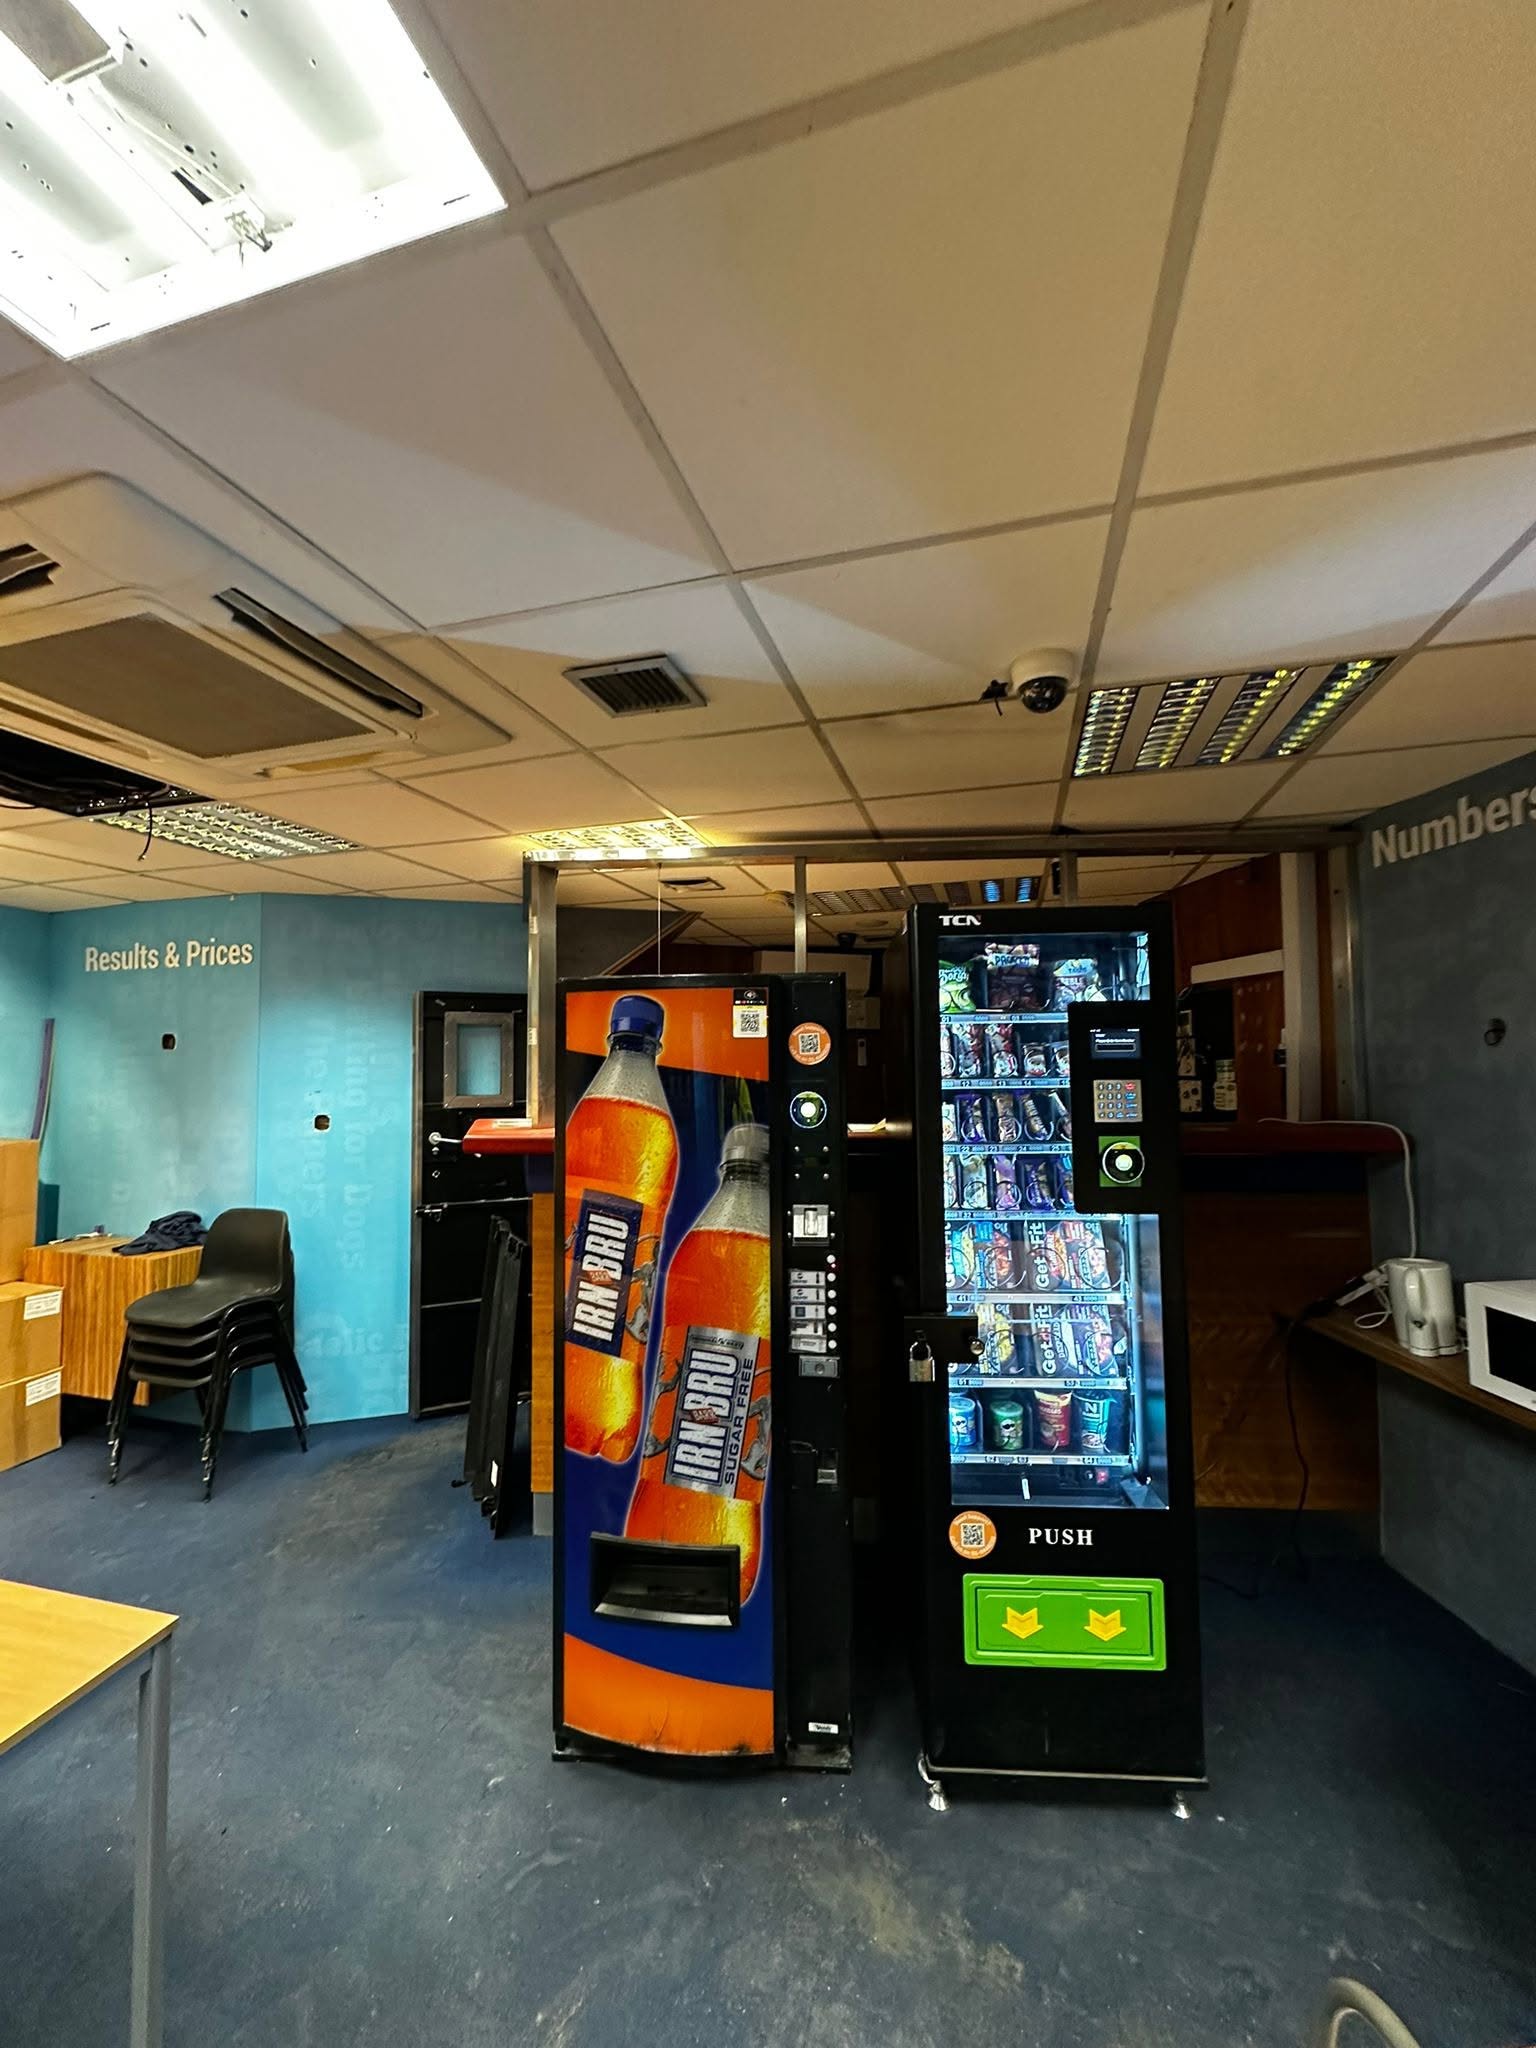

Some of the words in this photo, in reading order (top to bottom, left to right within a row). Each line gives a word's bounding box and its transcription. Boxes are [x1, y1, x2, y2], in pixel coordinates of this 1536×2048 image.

[938, 914, 982, 926] TCN
[85, 942, 159, 973] Results
[164, 941, 180, 967] &
[186, 937, 254, 968] Prices
[582, 1212, 630, 1283] BRU
[1029, 1221, 1045, 1246] Fit
[1034, 1256, 1050, 1288] Get
[572, 1281, 619, 1341] IRN
[1041, 1341, 1056, 1374] Get
[684, 1349, 738, 1421] BRU
[724, 1413, 745, 1484] SUGAR
[737, 1358, 755, 1411] FREE
[673, 1418, 727, 1484] IRN
[1028, 1527, 1094, 1546] PUSH
